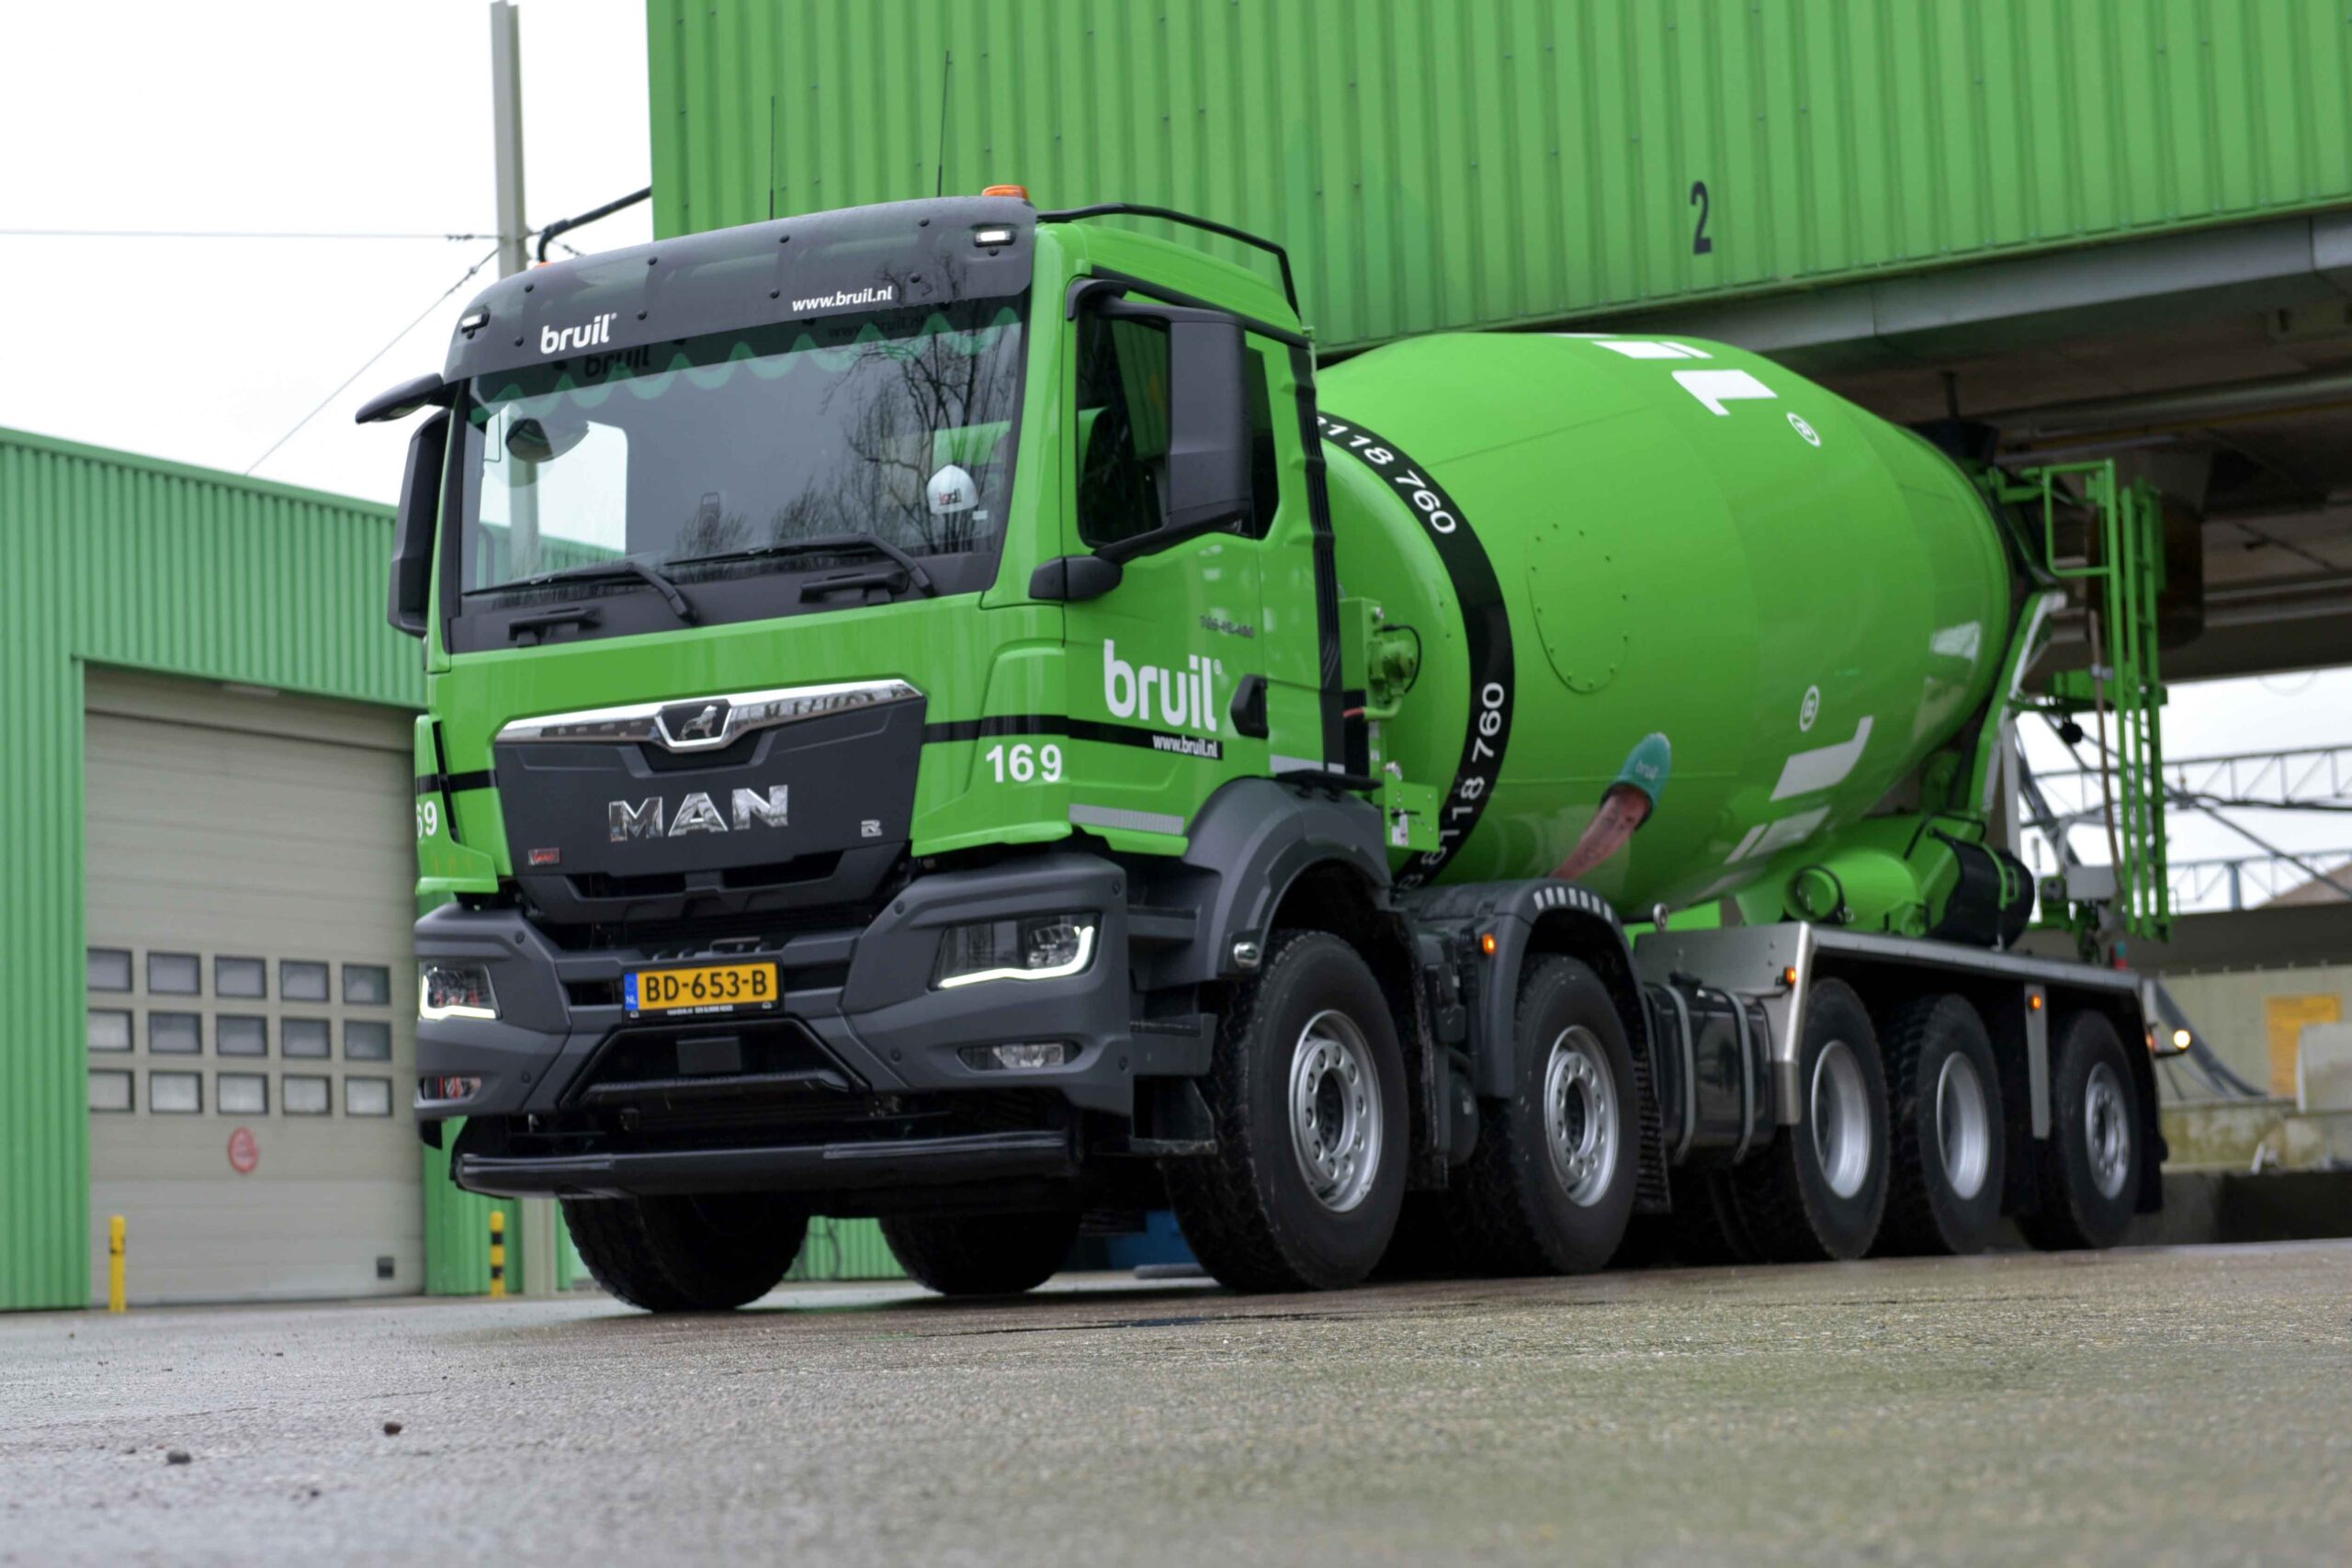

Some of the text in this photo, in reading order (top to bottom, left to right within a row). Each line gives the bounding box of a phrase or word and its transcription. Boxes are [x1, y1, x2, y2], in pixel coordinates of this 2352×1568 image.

[1690, 181, 1712, 254] 2
[792, 286, 893, 311] www.bruil.nl
[540, 313, 610, 355] bruil
[1395, 469, 1456, 534] 760
[1103, 638, 1217, 732] bruil
[1152, 735, 1218, 758] www.bruil.nl
[1472, 682, 1504, 763] 760
[986, 743, 1062, 783] 169
[609, 784, 788, 841] MAN
[646, 970, 767, 1002] BD-653-B
